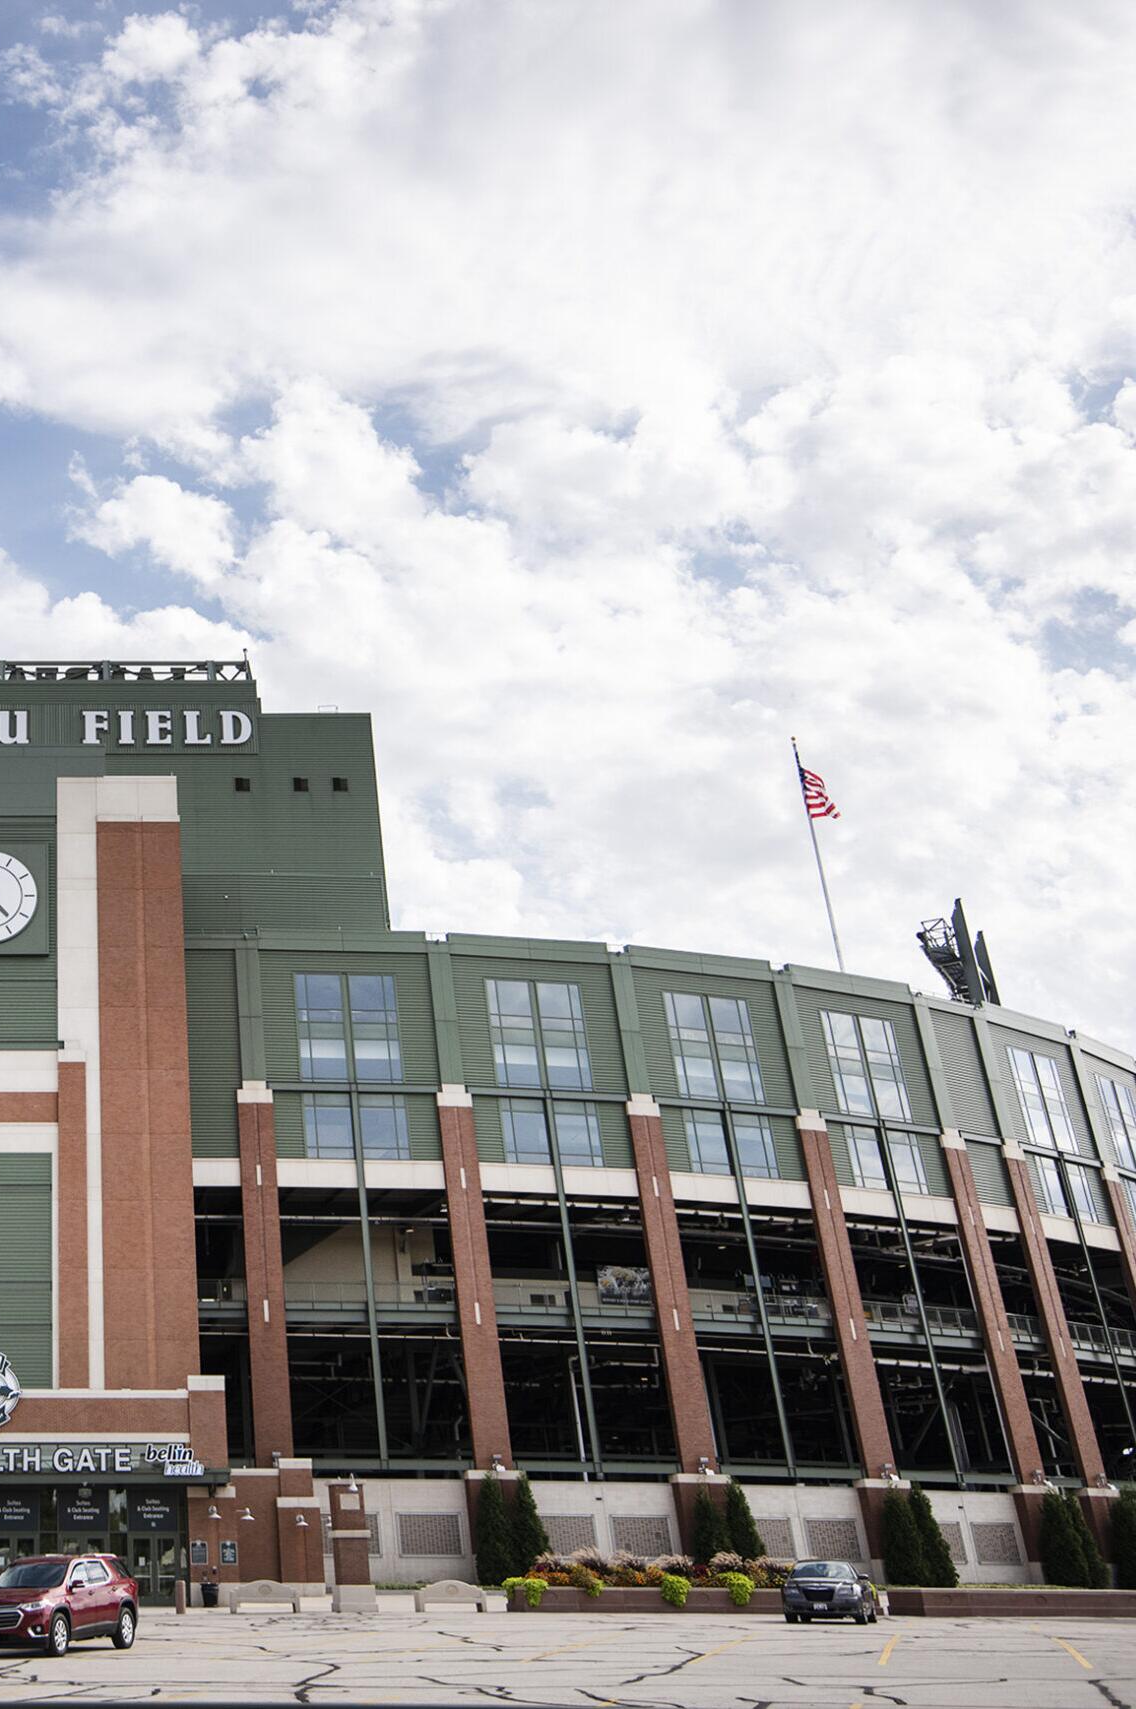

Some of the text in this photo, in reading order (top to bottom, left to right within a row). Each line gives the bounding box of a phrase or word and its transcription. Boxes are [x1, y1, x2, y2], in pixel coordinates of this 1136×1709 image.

[82, 710, 252, 745] FIELD
[53, 1448, 132, 1472] GATE
[146, 1445, 192, 1461] bellin
